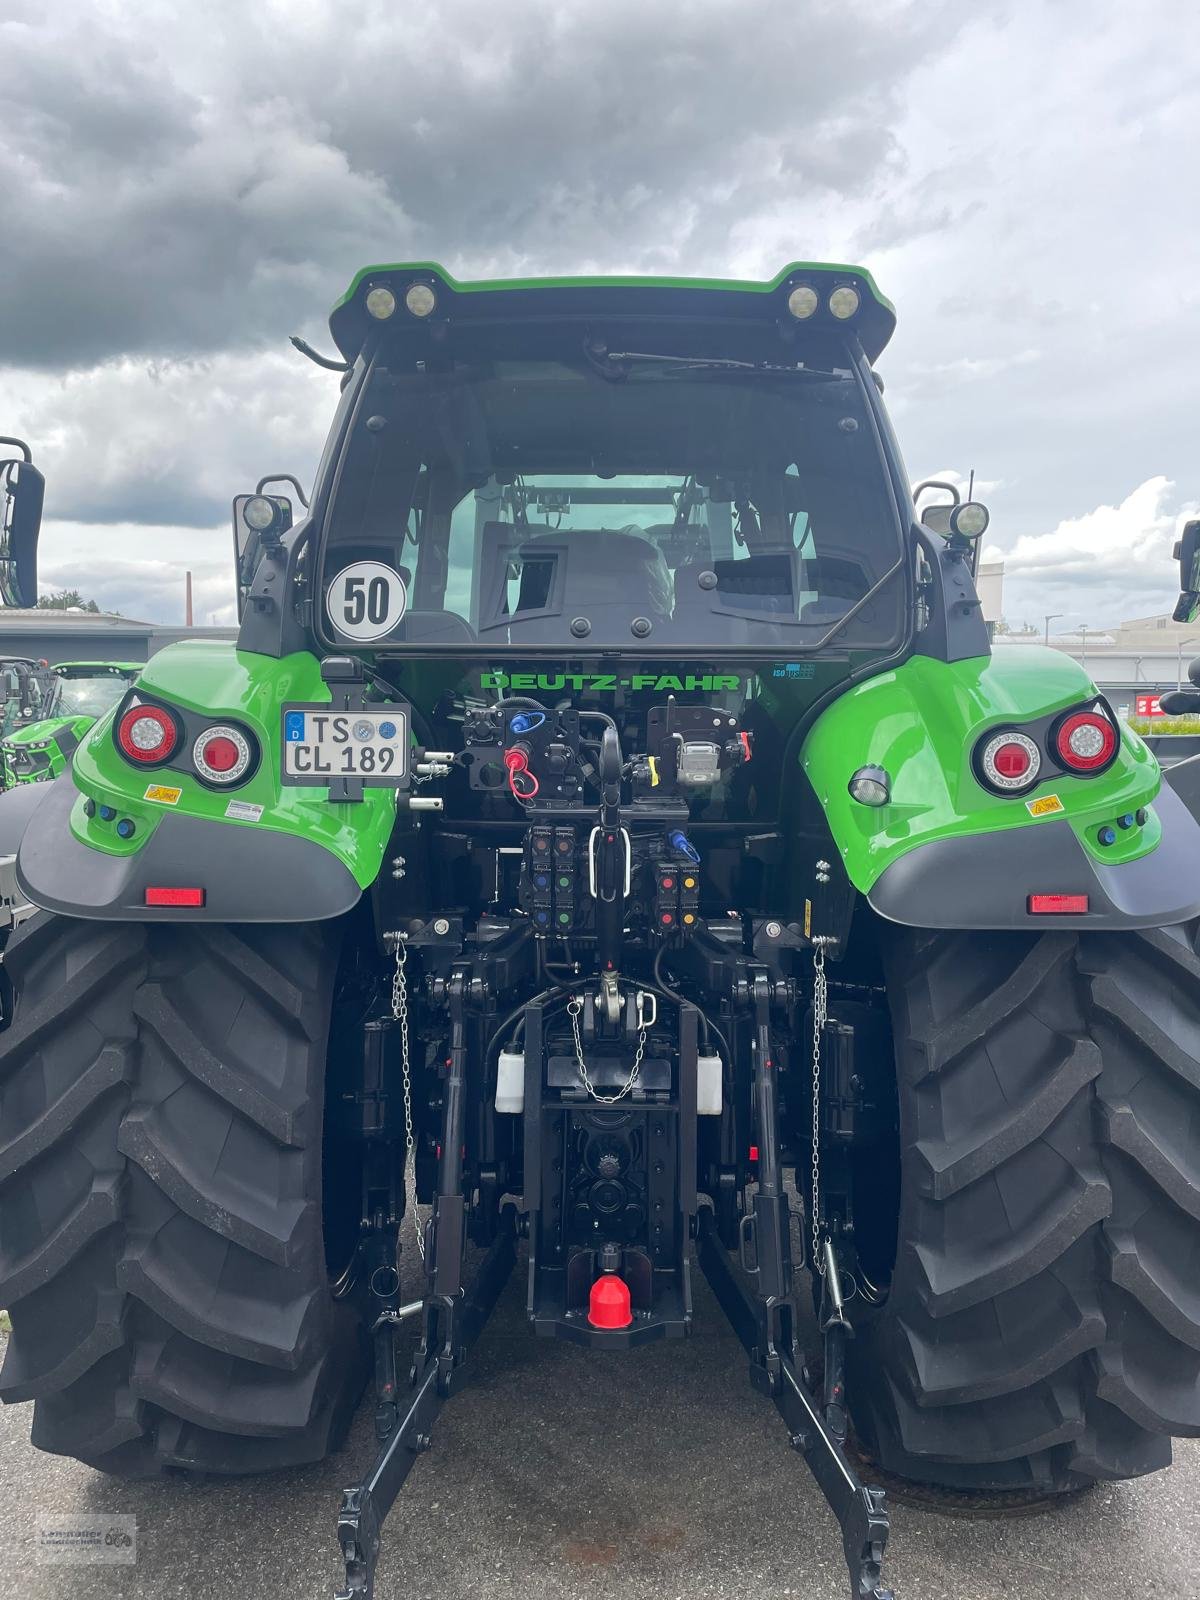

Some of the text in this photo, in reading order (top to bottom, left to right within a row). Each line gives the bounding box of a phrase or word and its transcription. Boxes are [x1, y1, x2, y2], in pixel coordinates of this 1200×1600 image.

[344, 577, 389, 625] 50
[480, 673, 741, 691] DEUTZ-FAHR
[292, 730, 300, 740] D
[312, 717, 349, 743] TS
[294, 745, 395, 773] CL 189
